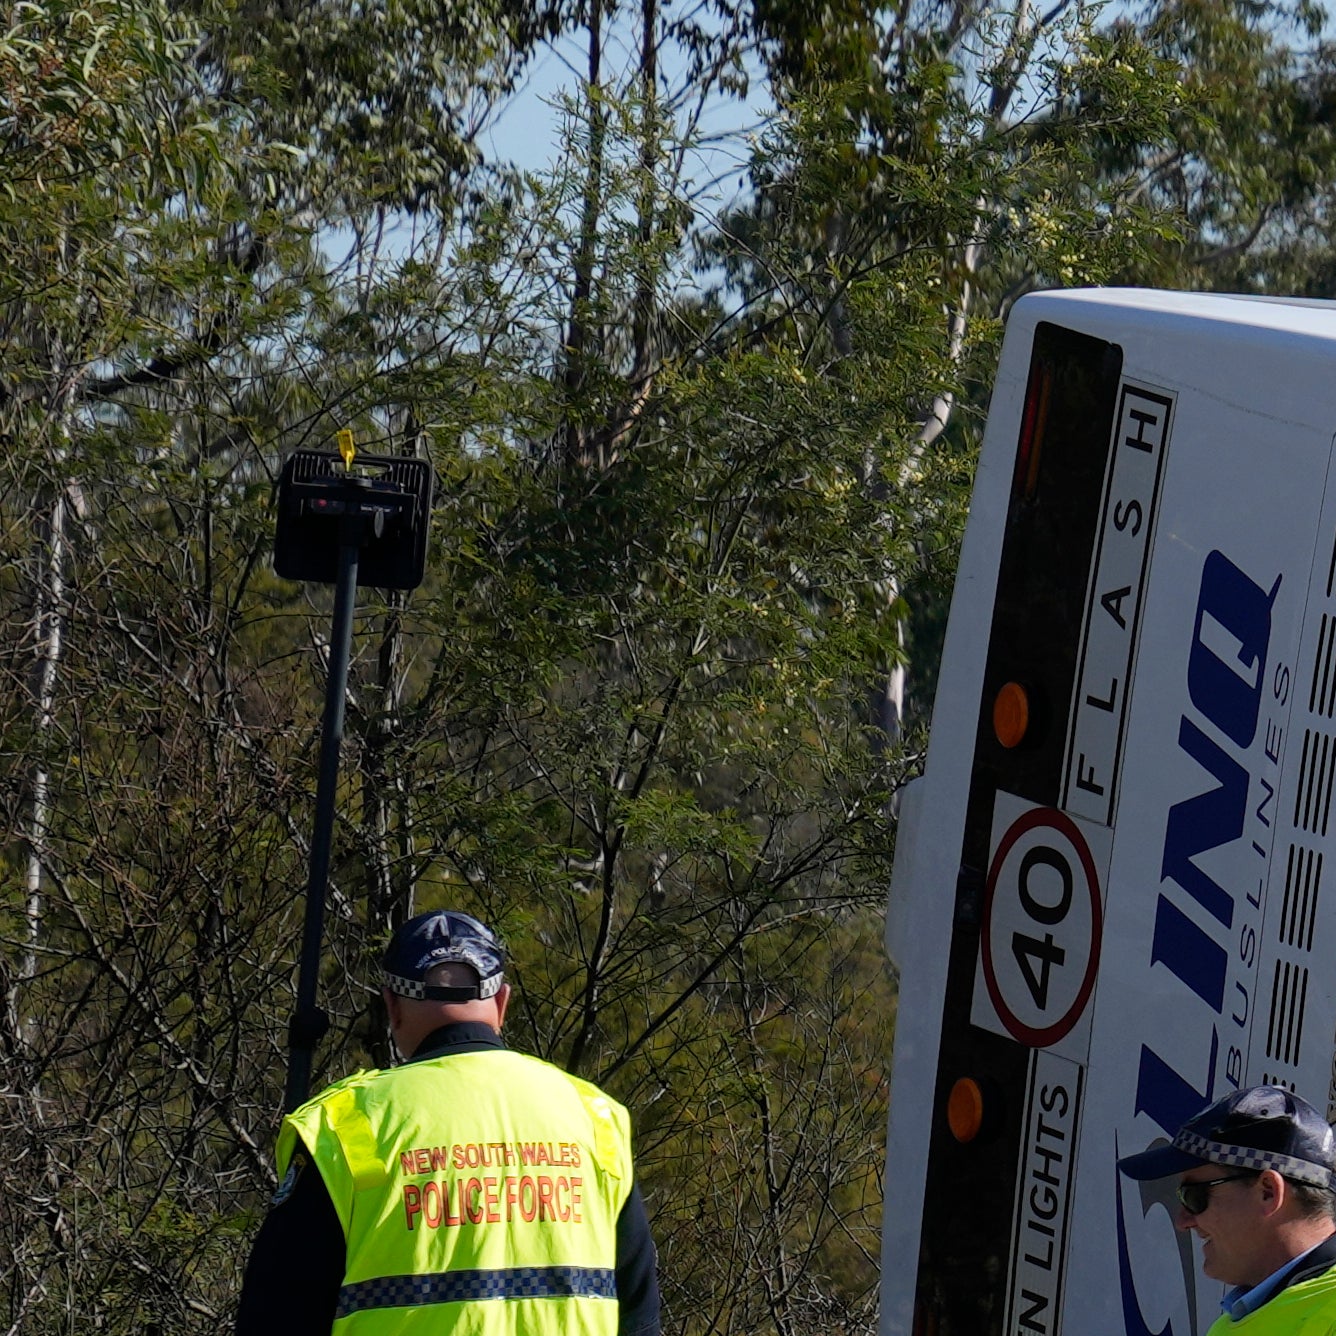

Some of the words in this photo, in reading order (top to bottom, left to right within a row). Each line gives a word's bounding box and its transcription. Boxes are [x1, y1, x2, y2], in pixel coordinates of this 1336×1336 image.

[1076, 410, 1157, 796] FLASH
[1012, 846, 1073, 1010] 40
[1134, 550, 1281, 1137] LINQ
[1225, 662, 1289, 1090] BUSLINES
[401, 1146, 447, 1176] NEW
[452, 1143, 516, 1169] SOUTH
[517, 1142, 581, 1169] WALES
[403, 1177, 501, 1231] POLICE
[505, 1175, 583, 1224] FORCE
[1024, 1084, 1069, 1271] LIGHTS
